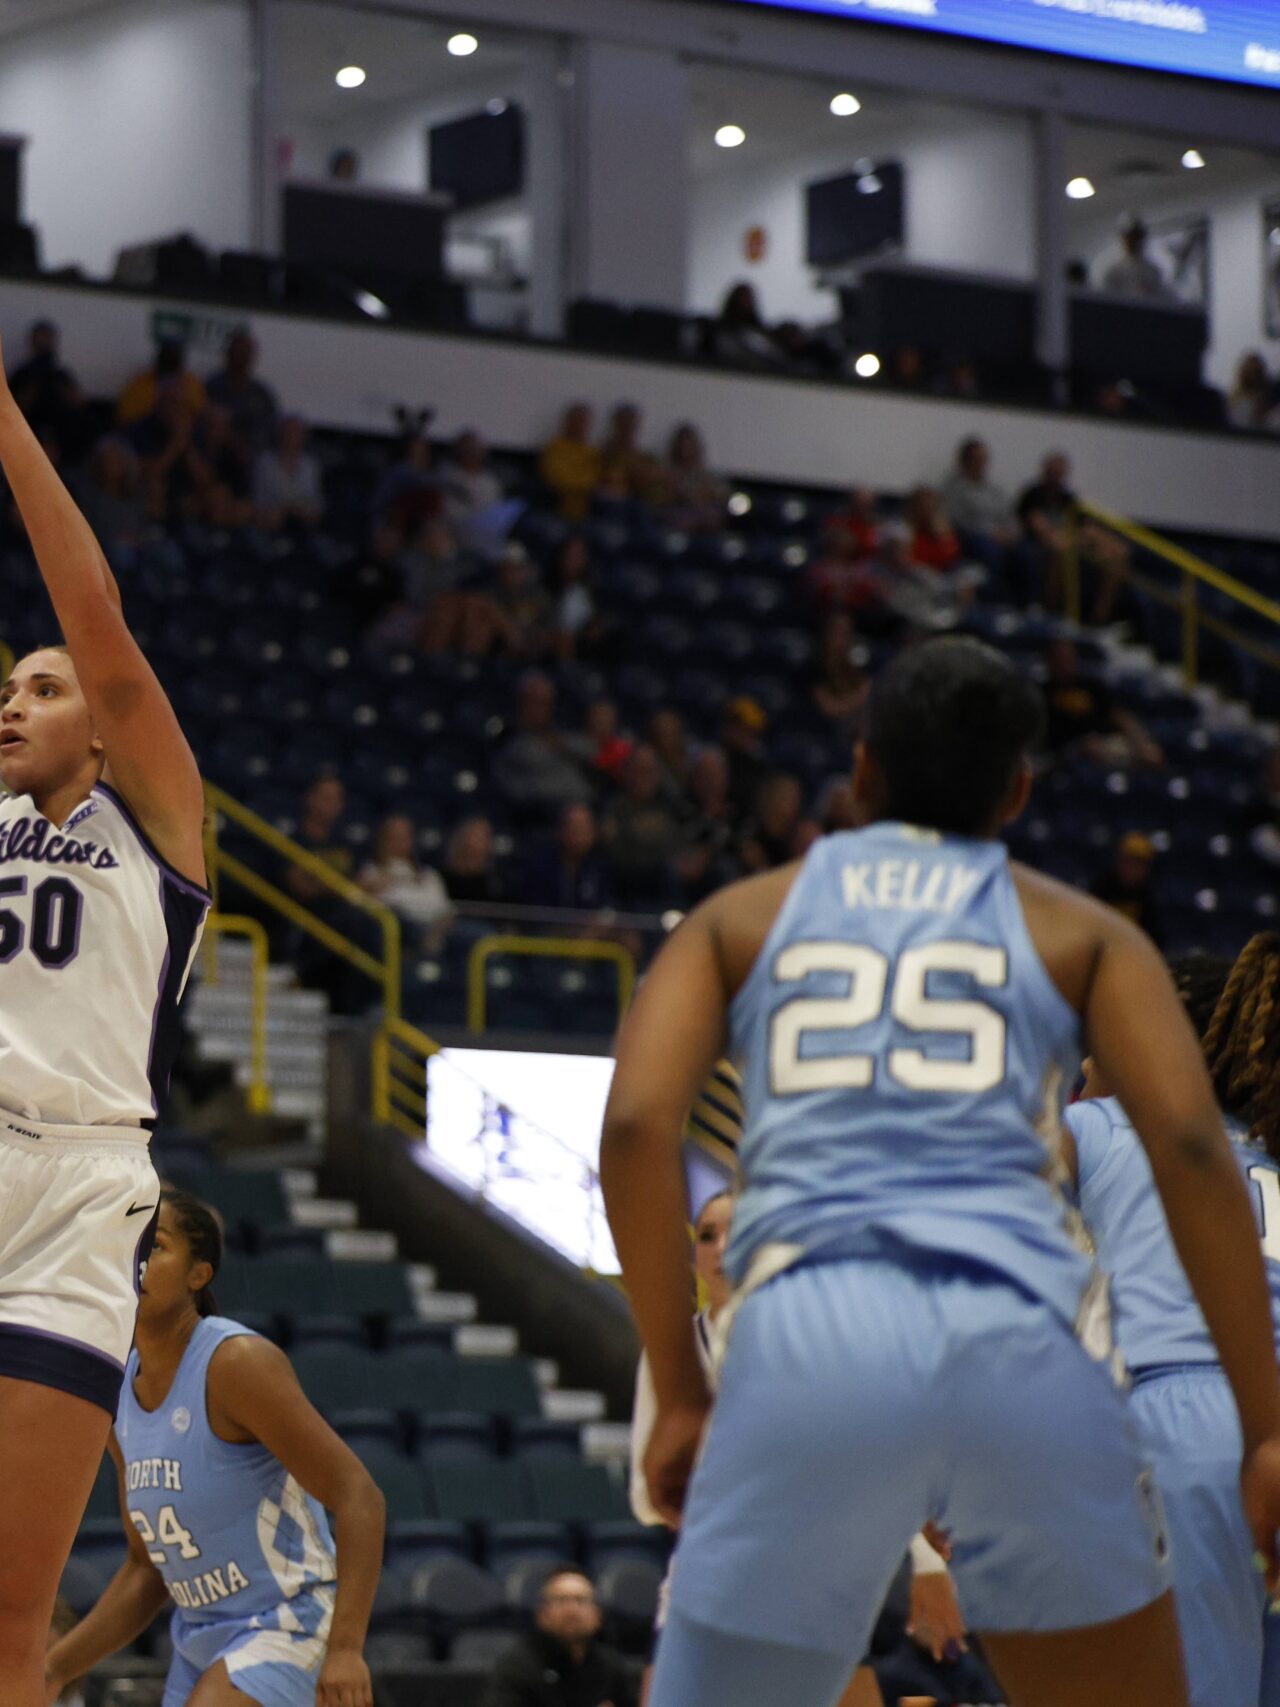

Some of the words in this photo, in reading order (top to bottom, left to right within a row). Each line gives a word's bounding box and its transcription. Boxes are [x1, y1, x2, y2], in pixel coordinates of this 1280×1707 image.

[842, 858, 978, 913] KELLY
[771, 939, 1008, 1095] 25
[127, 1458, 183, 1491] ORTH
[169, 1561, 249, 1609] OLINA
